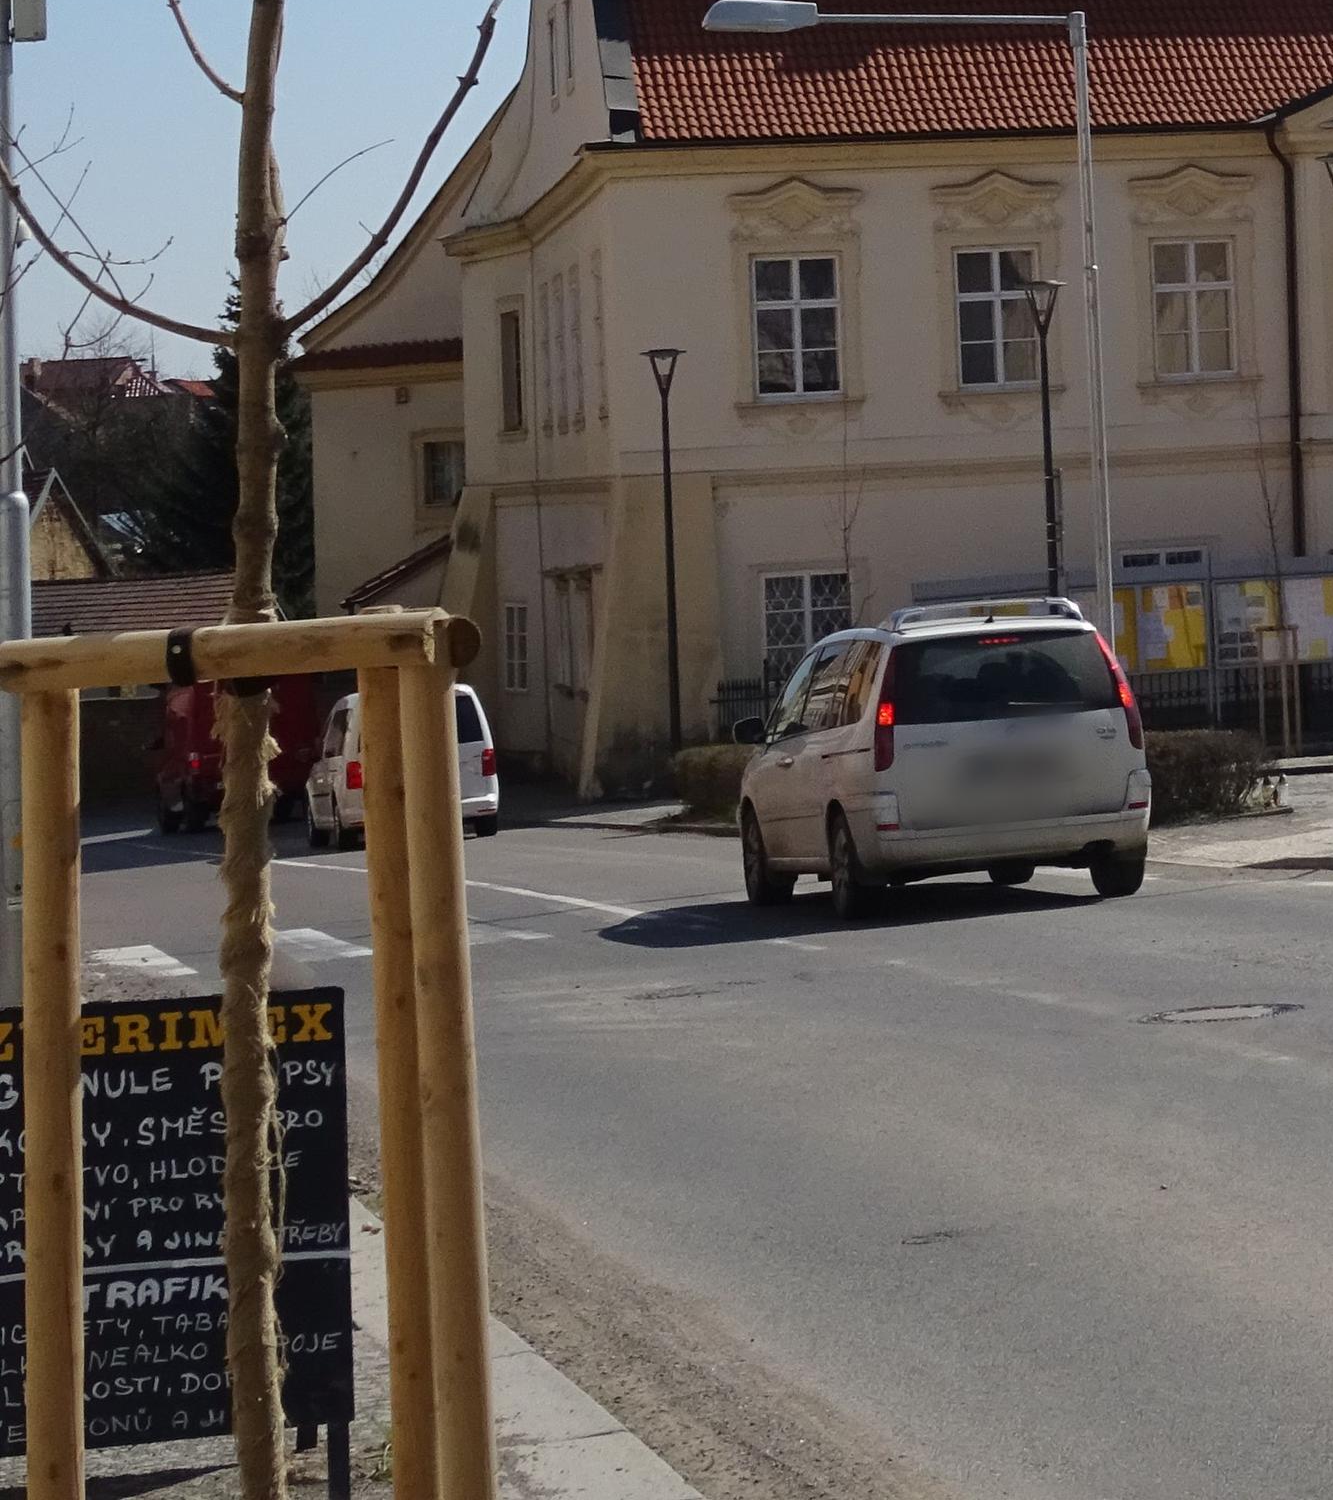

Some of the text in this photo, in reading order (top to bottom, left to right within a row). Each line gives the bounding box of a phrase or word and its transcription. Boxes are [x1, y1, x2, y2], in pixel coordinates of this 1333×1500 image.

[0, 1067, 173, 1110] GNULE
[137, 1106, 228, 1145] SMĚS
[128, 1197, 184, 1218] PRO
[88, 1342, 208, 1373] NEALKO
